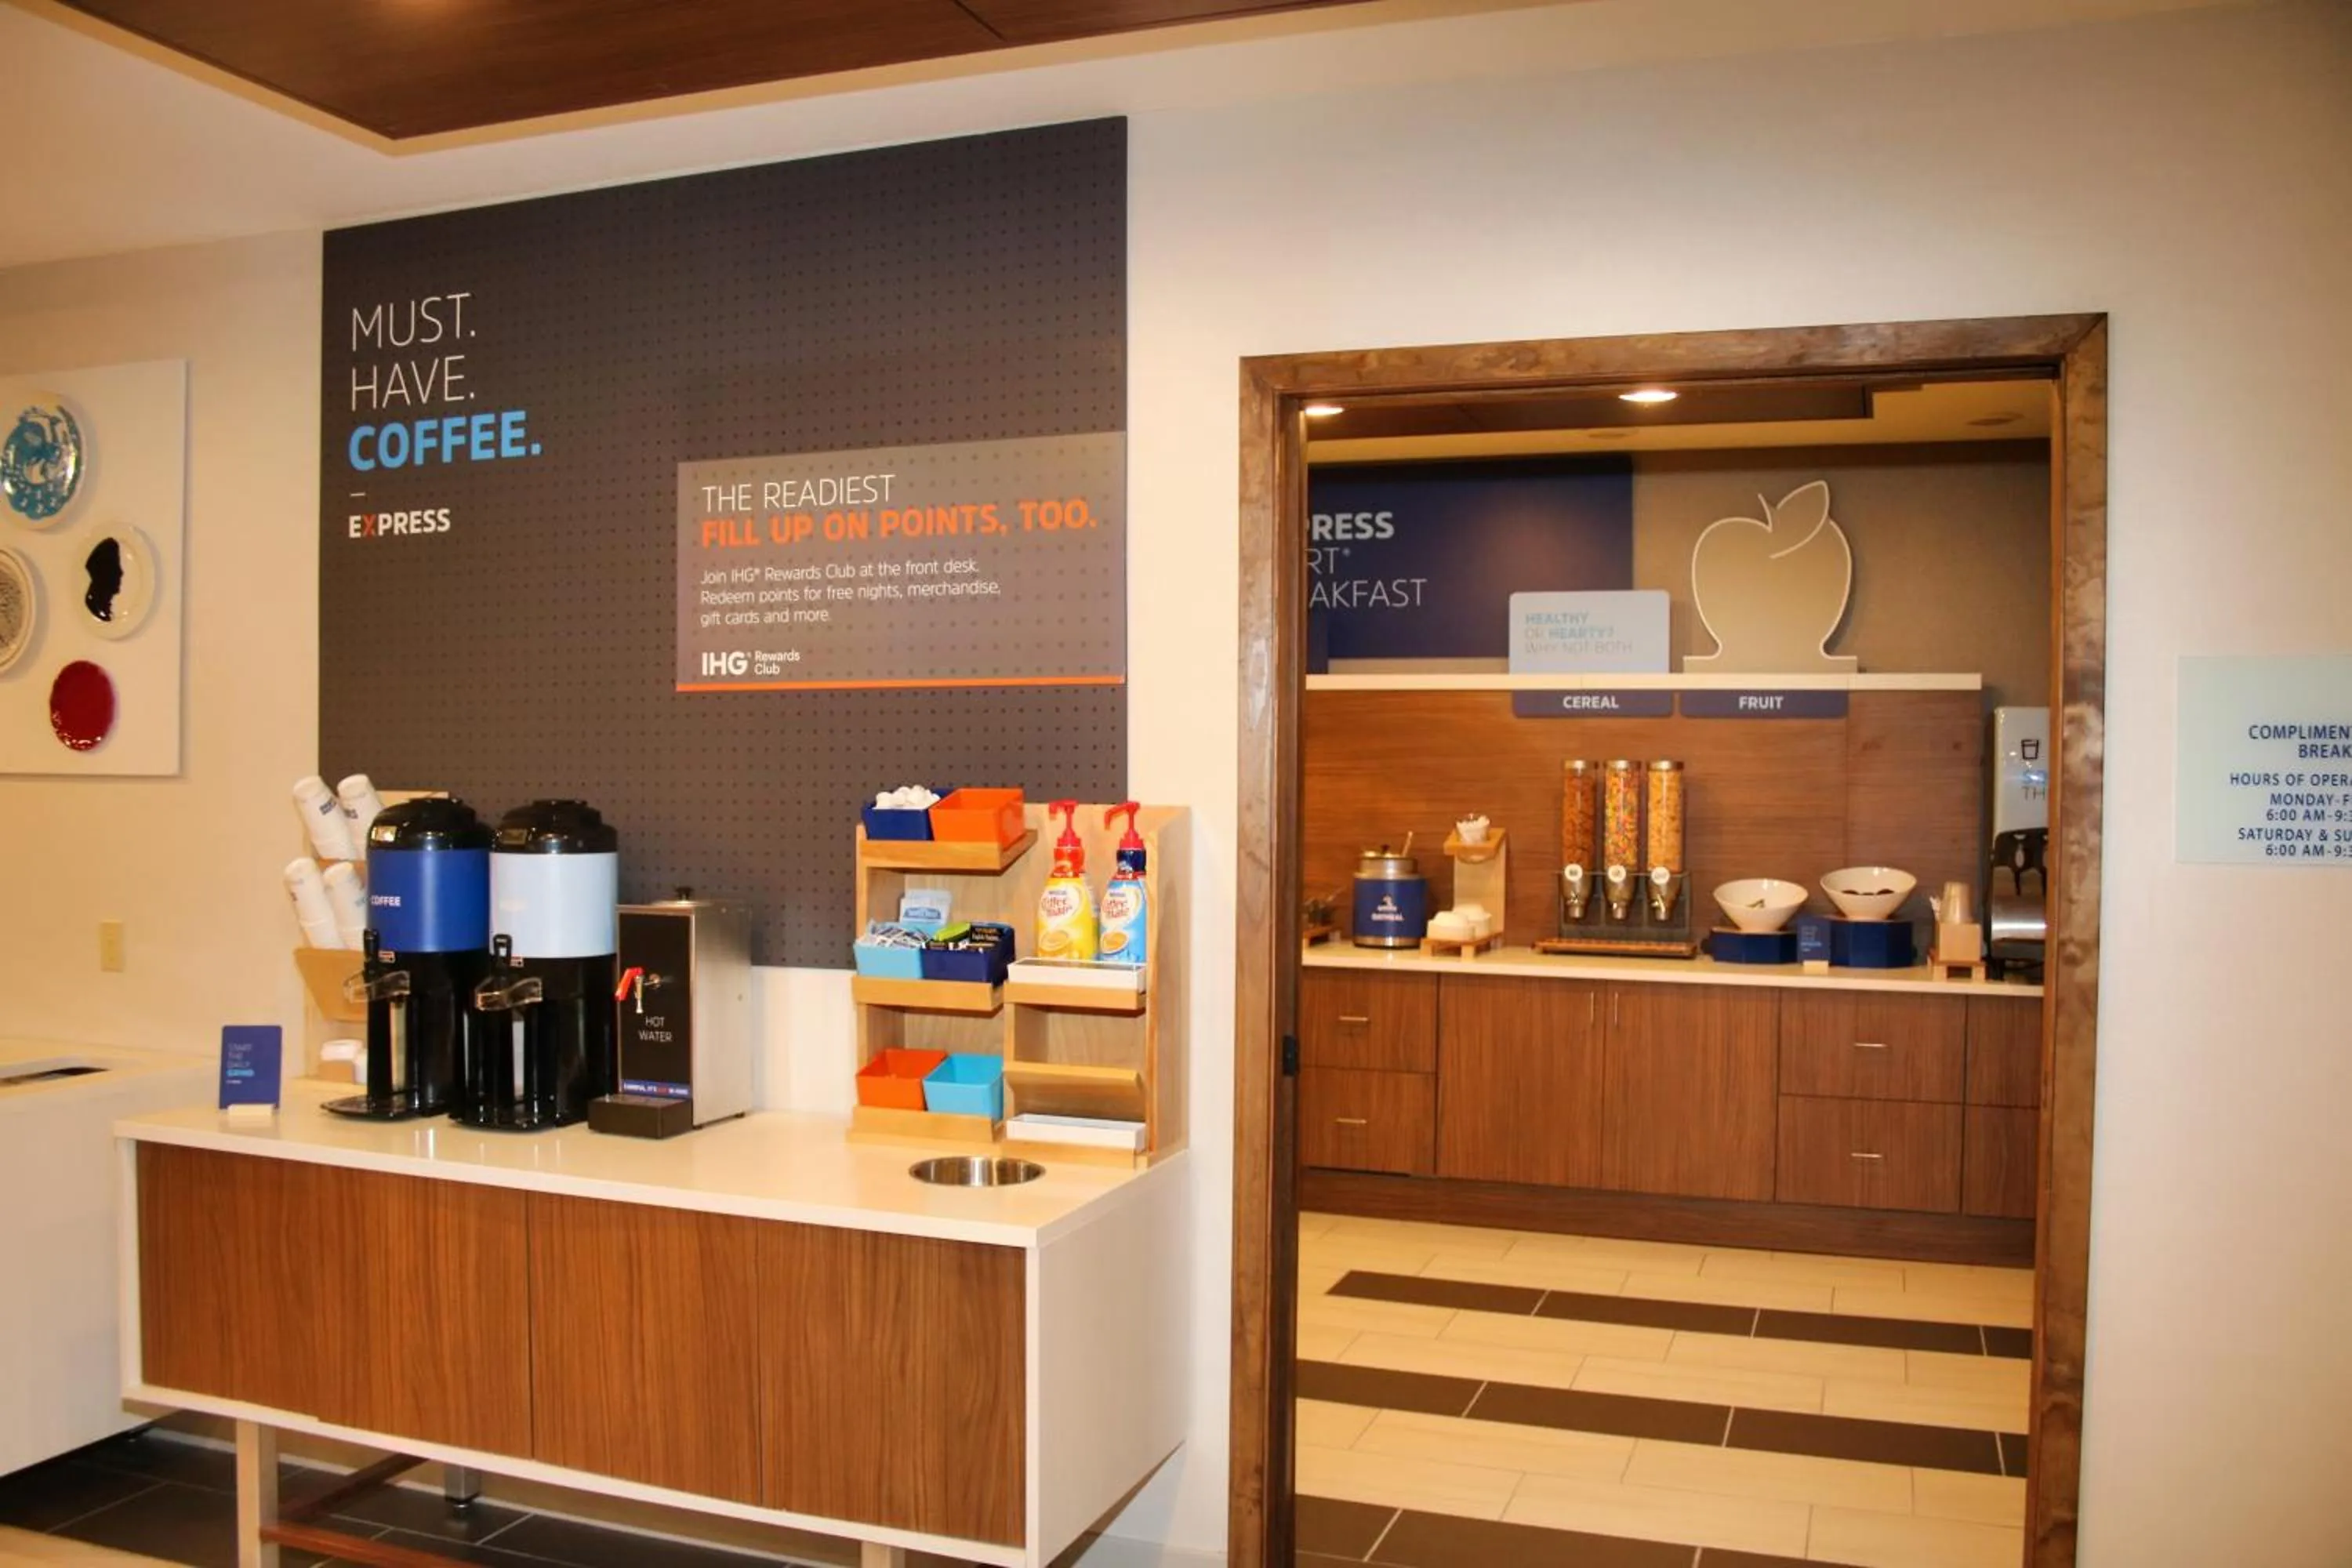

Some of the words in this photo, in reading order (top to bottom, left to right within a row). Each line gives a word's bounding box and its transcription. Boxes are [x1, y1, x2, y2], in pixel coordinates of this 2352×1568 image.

[353, 292, 476, 351] MUST.
[352, 355, 474, 412] HAVE.
[349, 411, 542, 471] COFFEE.
[702, 484, 752, 512] THE
[764, 474, 896, 509] READIEST
[349, 509, 451, 538] EXPRESS
[702, 517, 760, 547] FILL
[770, 513, 813, 543] UP
[824, 510, 869, 542] ON
[880, 504, 1007, 537] POINTS,
[1019, 498, 1097, 532] TOO.
[1307, 511, 1395, 540] RESS
[701, 570, 727, 584] Join
[764, 565, 822, 581] Rewards
[826, 563, 855, 579] Club
[859, 564, 874, 578] at
[878, 561, 901, 576] the
[906, 560, 938, 575] front
[701, 590, 755, 605] Redeem
[759, 587, 800, 604] points
[804, 586, 822, 601] for
[827, 586, 854, 600] free
[858, 583, 902, 601] nights,
[1308, 579, 1428, 608] AKFAST
[700, 612, 721, 627] gift
[725, 610, 760, 624] cards
[763, 608, 789, 623] and
[754, 648, 800, 662] Rewards
[753, 662, 780, 675] Club
[1563, 695, 1619, 709] CEREAL
[1739, 696, 1784, 710] FRUIT
[2249, 724, 2352, 739] COMPLIMEN
[2298, 744, 2352, 758] BREAK
[2230, 772, 2279, 786] HOURS
[2285, 774, 2305, 786] OF
[2310, 774, 2352, 786] OPER
[2266, 808, 2297, 822] 6:00
[2238, 828, 2313, 841] SATURDAY
[2318, 829, 2328, 841] &
[2266, 844, 2296, 856] 6:00
[645, 1016, 665, 1028] HOT
[638, 1029, 673, 1043] WATER
